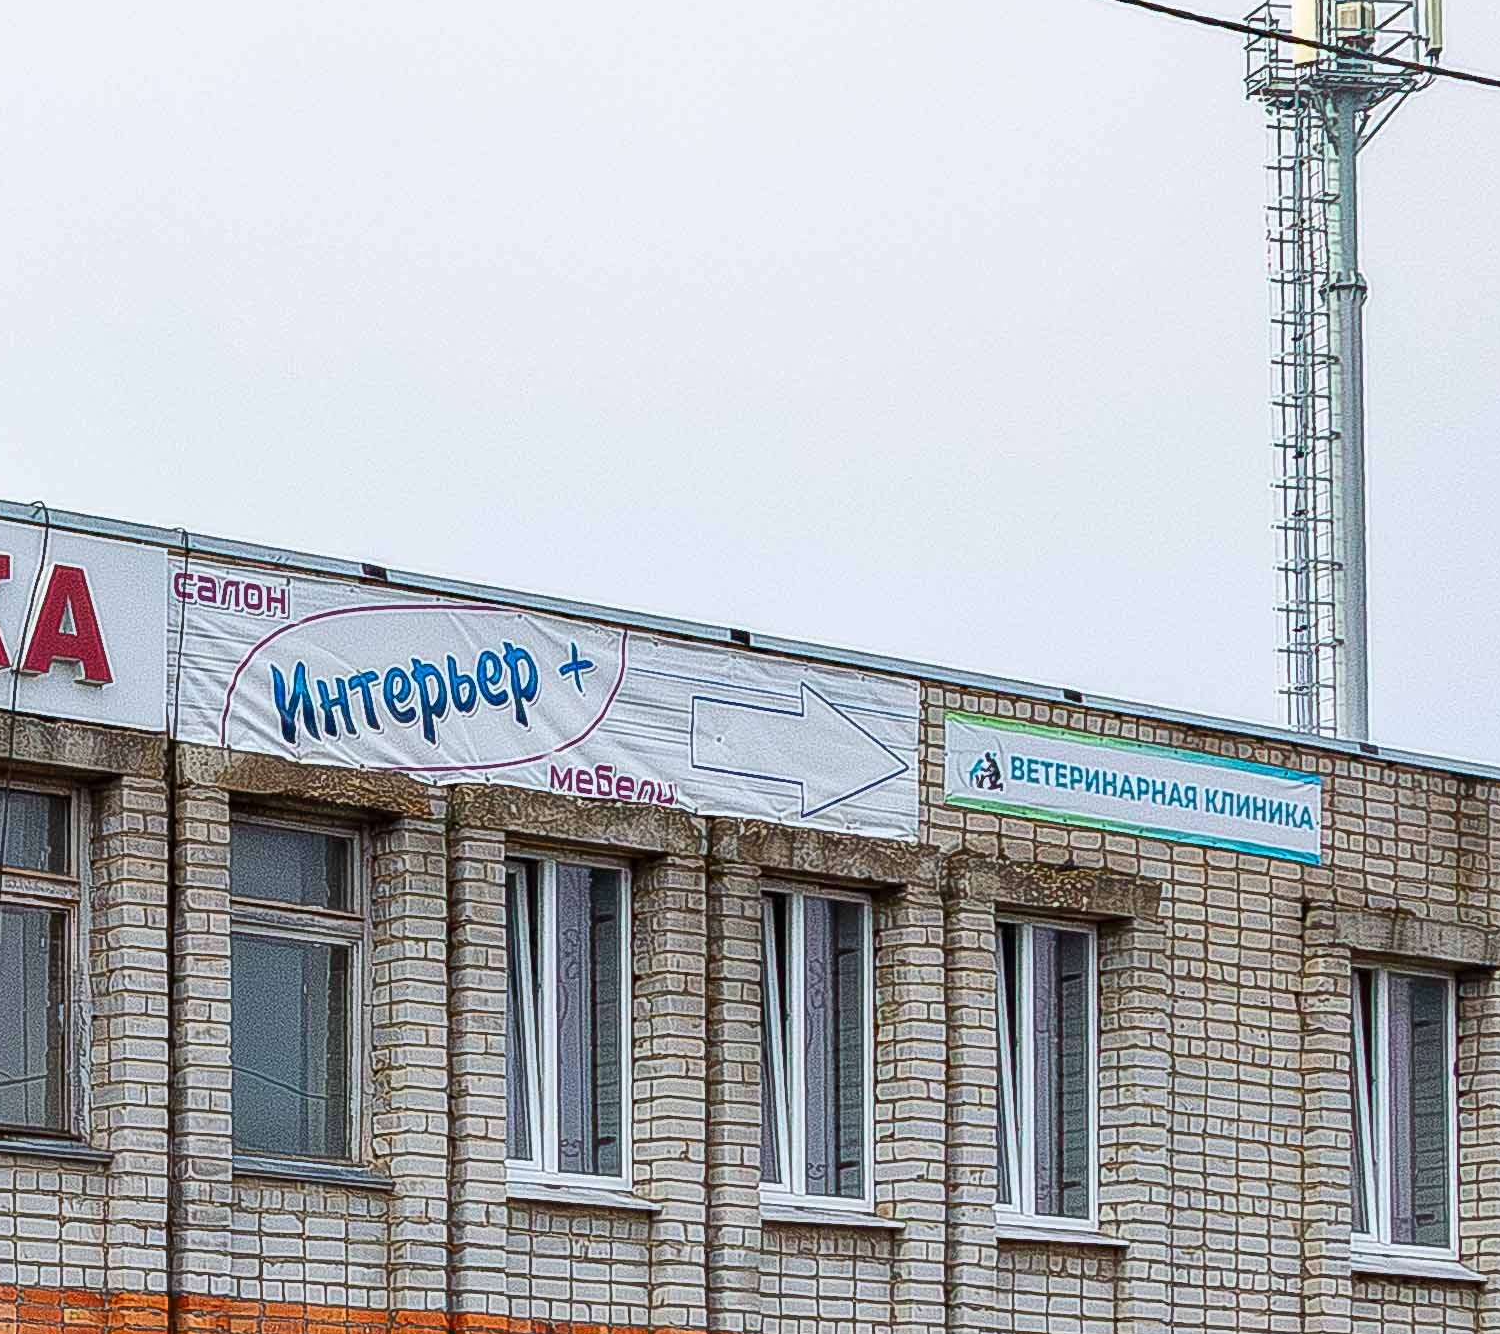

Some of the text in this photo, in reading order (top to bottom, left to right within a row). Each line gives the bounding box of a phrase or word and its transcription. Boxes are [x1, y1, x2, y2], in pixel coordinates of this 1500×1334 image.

[173, 571, 288, 617] салон
[270, 639, 541, 744] Интерьер
[549, 763, 678, 805] мебели
[1010, 754, 1315, 831] ВЕТЕРИНАРНАЯ КЛИНИКА
